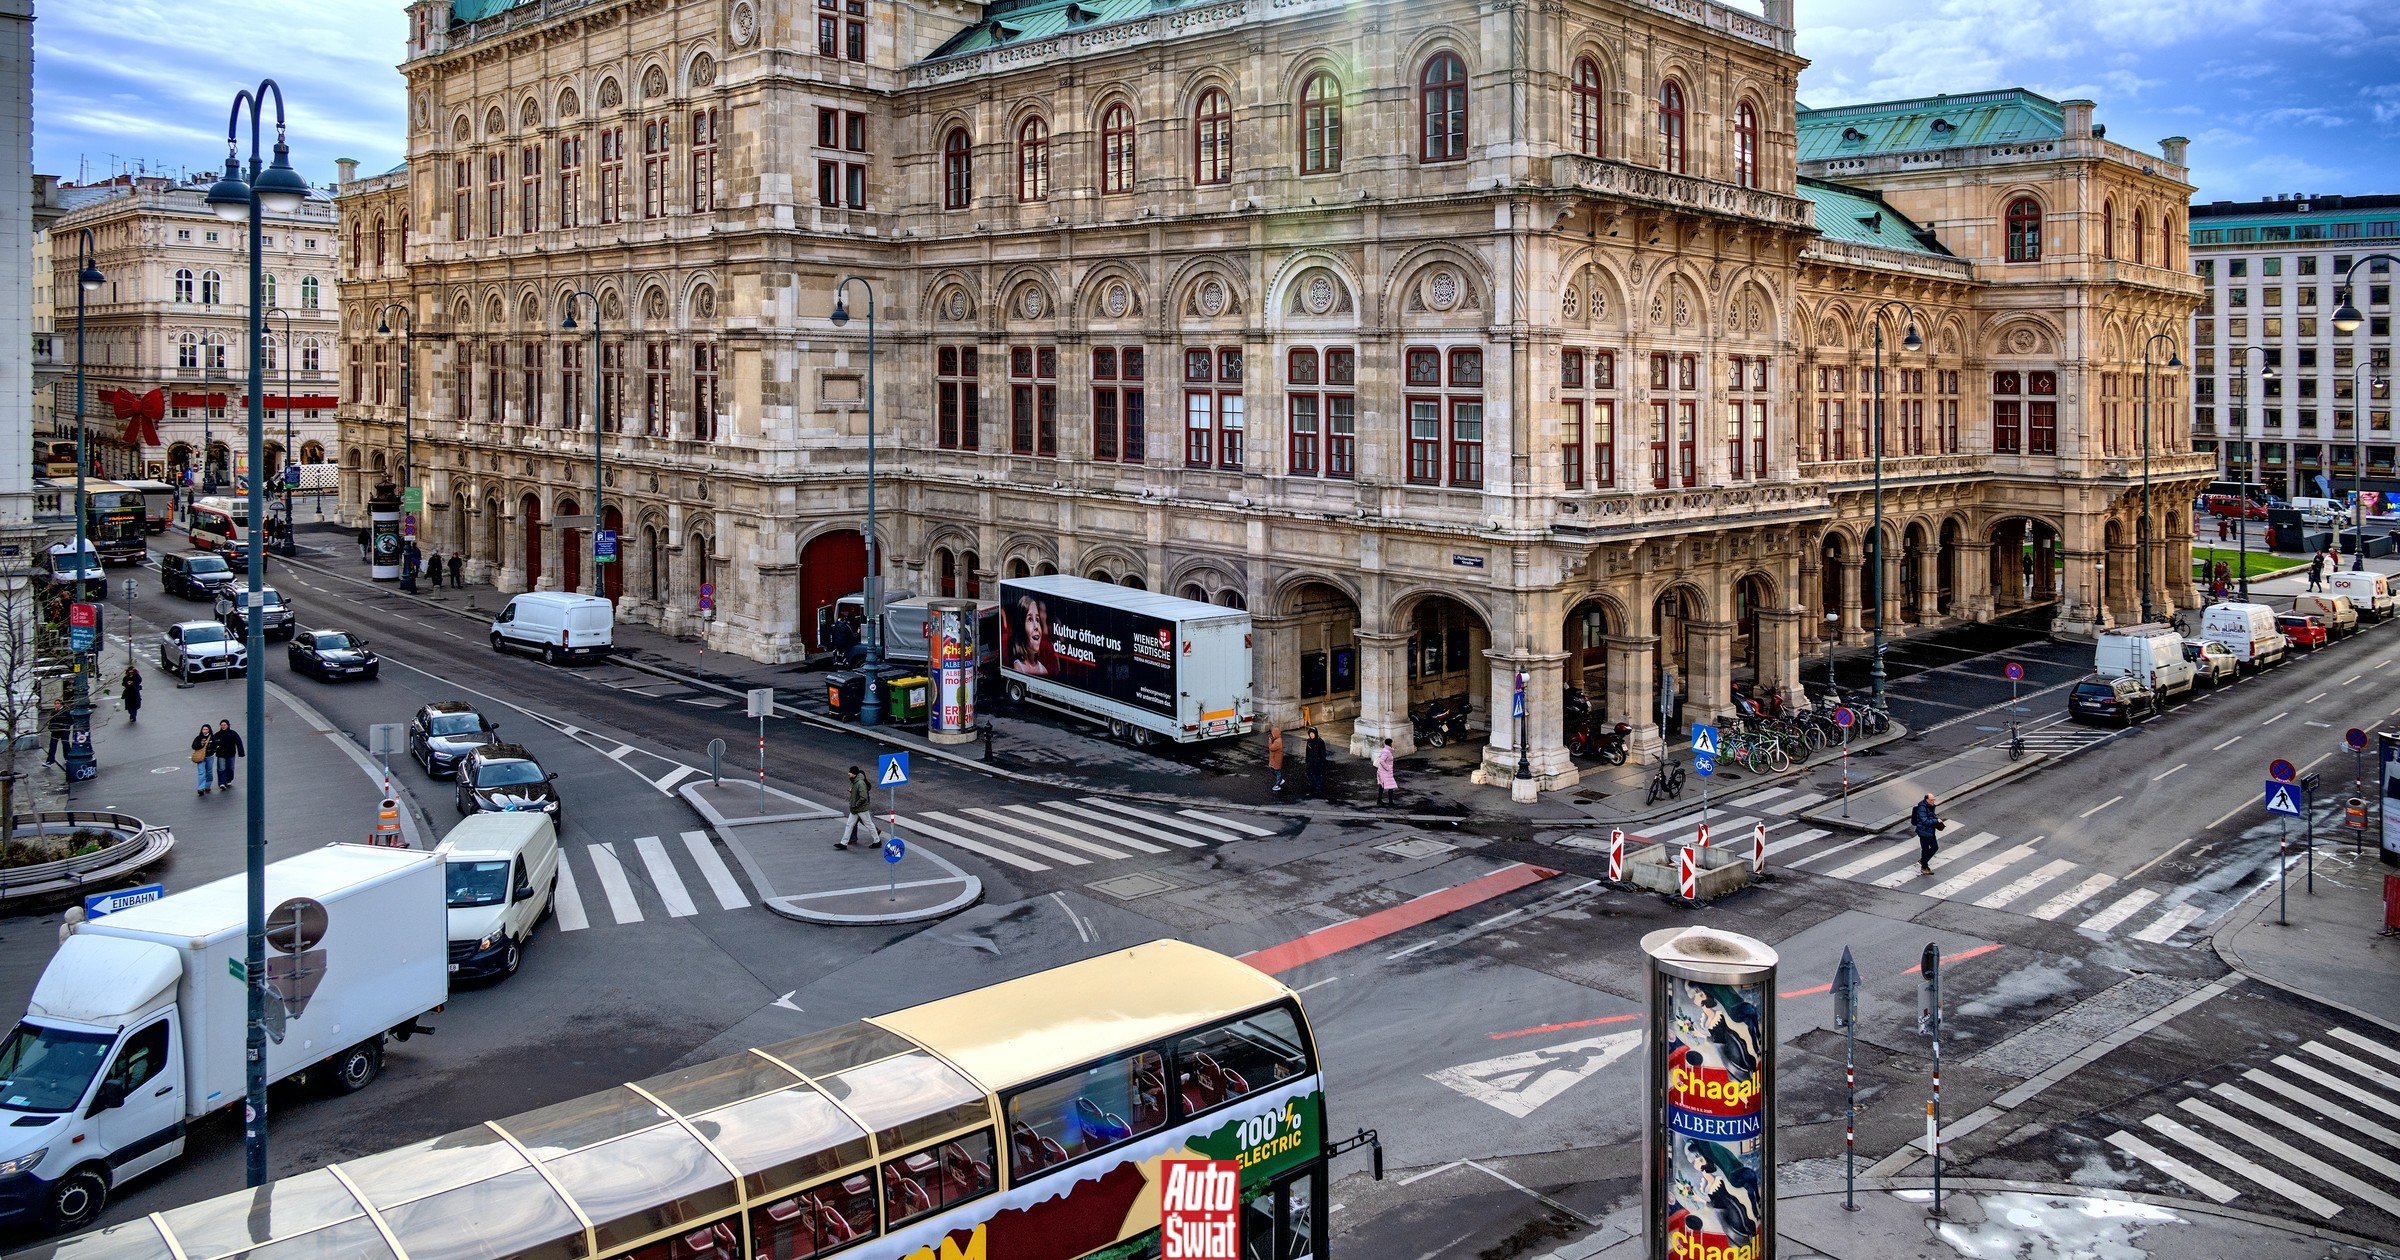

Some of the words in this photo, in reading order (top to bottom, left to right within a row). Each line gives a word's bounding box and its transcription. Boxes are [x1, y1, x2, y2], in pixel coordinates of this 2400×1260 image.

[1053, 623, 1077, 640] Kultur
[1079, 629, 1104, 647] öffnet
[1106, 639, 1121, 651] uns
[1133, 632, 1158, 647] WIENER
[1053, 641, 1066, 654] die
[1068, 644, 1096, 662] Augen.
[1134, 643, 1170, 660] STÄDTISCHE
[113, 893, 155, 909] EINBAHN
[1672, 1068, 1761, 1107] Chagall
[1236, 1103, 1301, 1150] 100%
[1672, 1112, 1760, 1135] ALBERTINA
[1235, 1130, 1301, 1170] ELECTRIC
